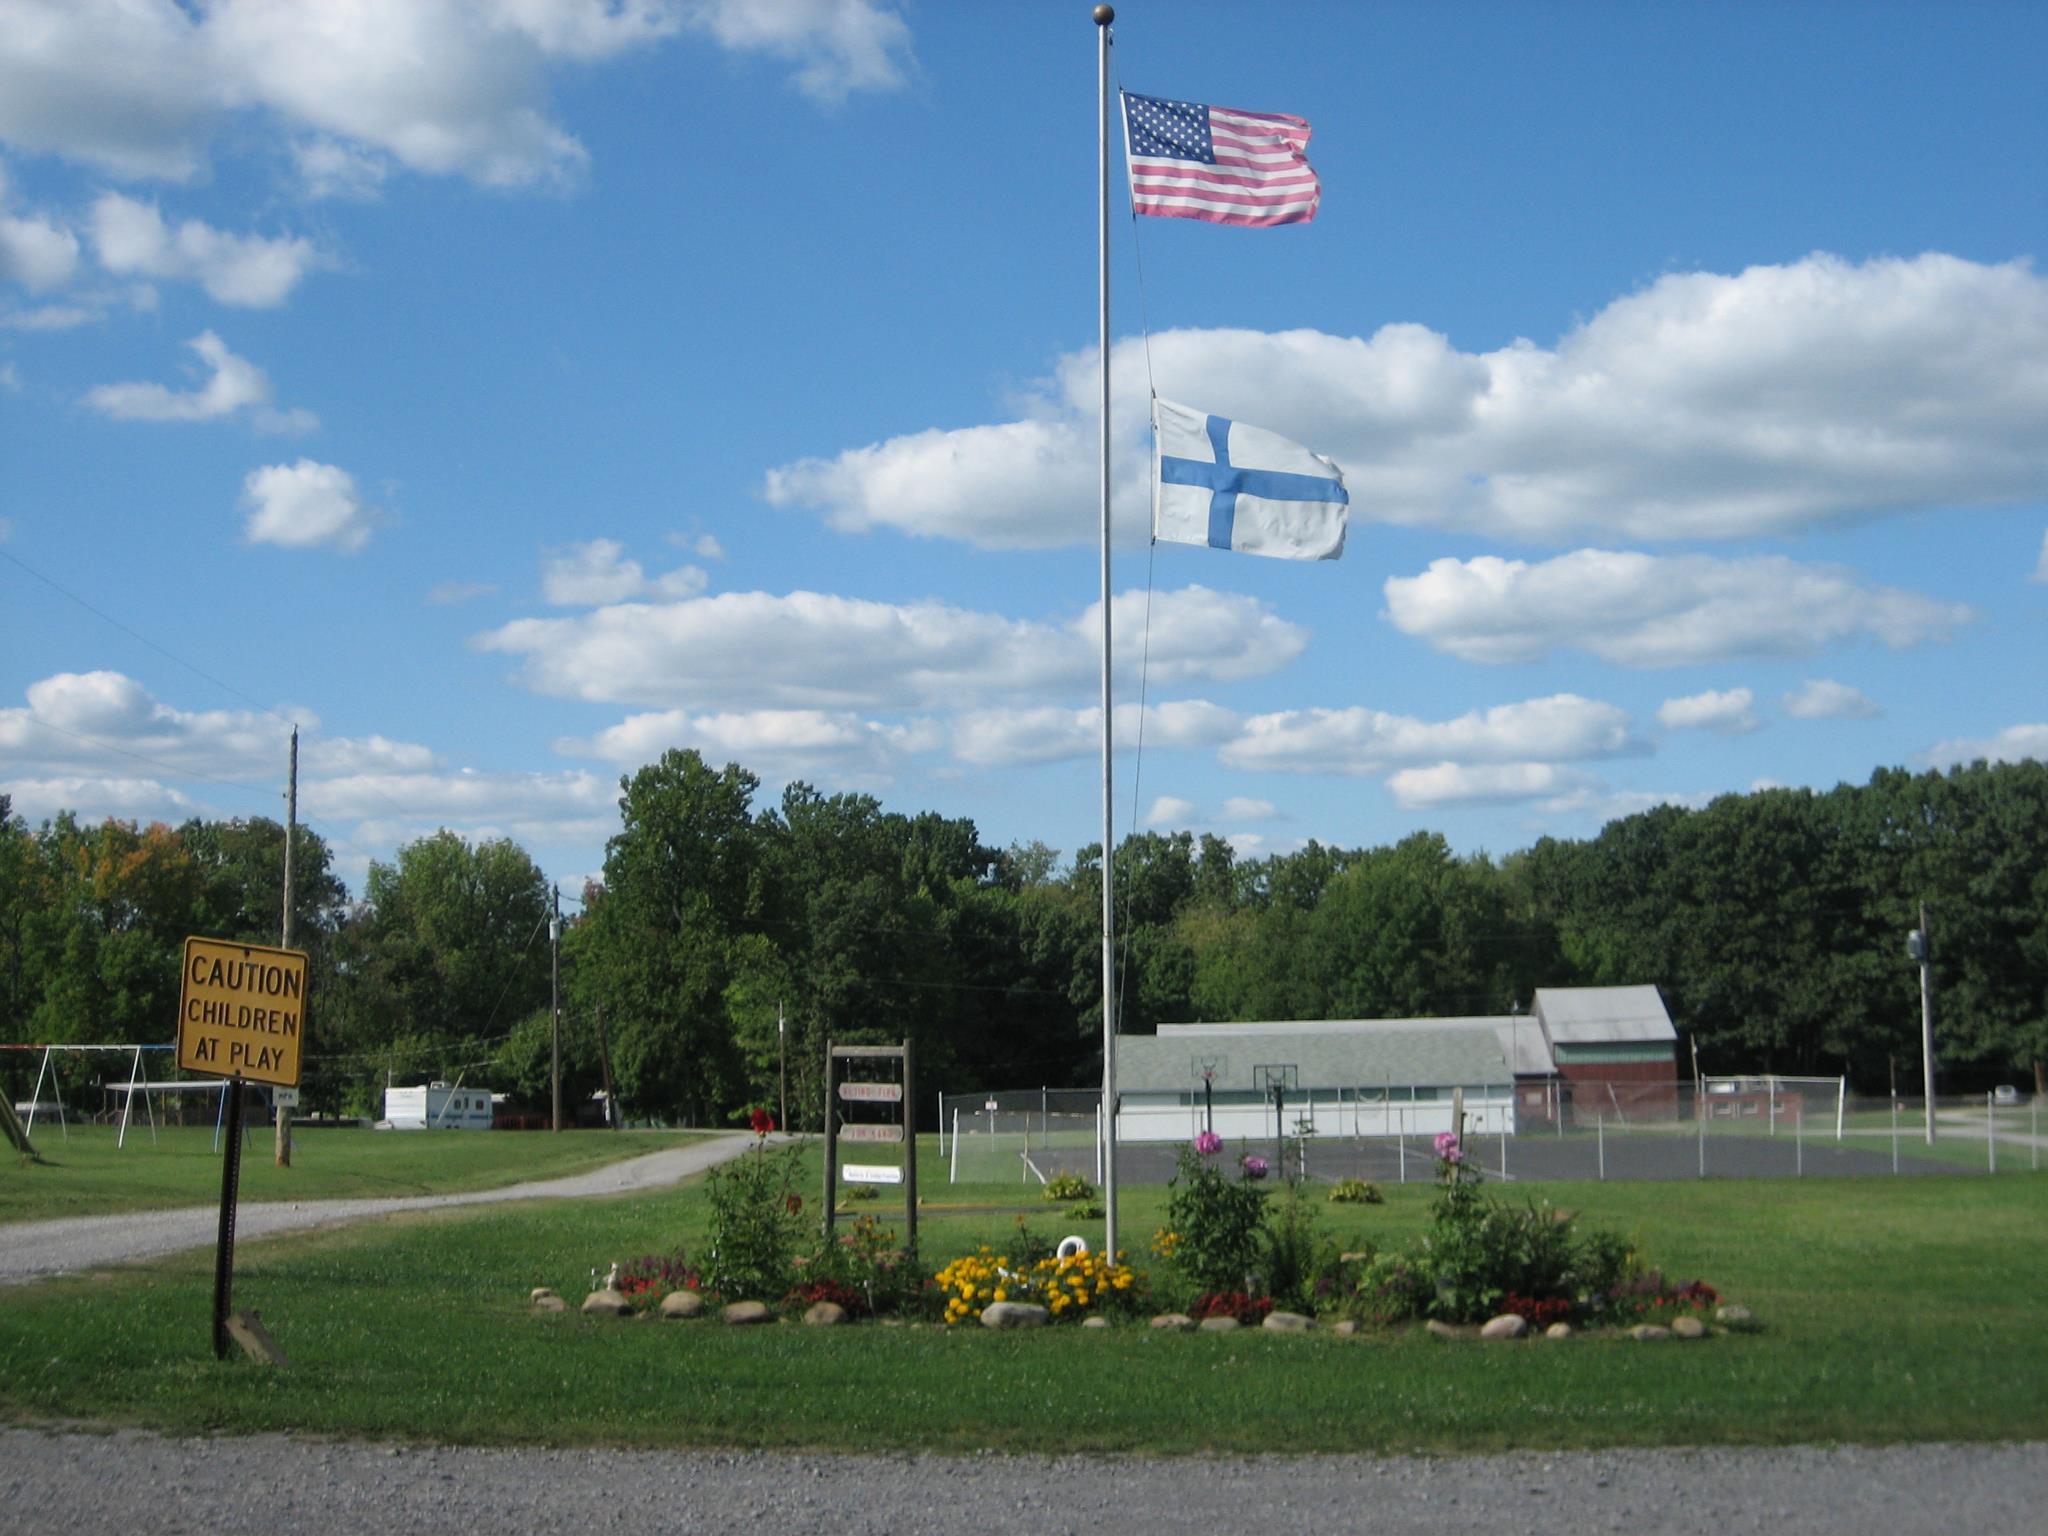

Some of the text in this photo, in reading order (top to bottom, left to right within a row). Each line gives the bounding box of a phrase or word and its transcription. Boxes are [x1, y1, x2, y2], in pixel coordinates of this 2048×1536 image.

[191, 955, 300, 999] CAUTION
[188, 998, 297, 1036] CHILDREN
[195, 1037, 284, 1072] AT PLAY
